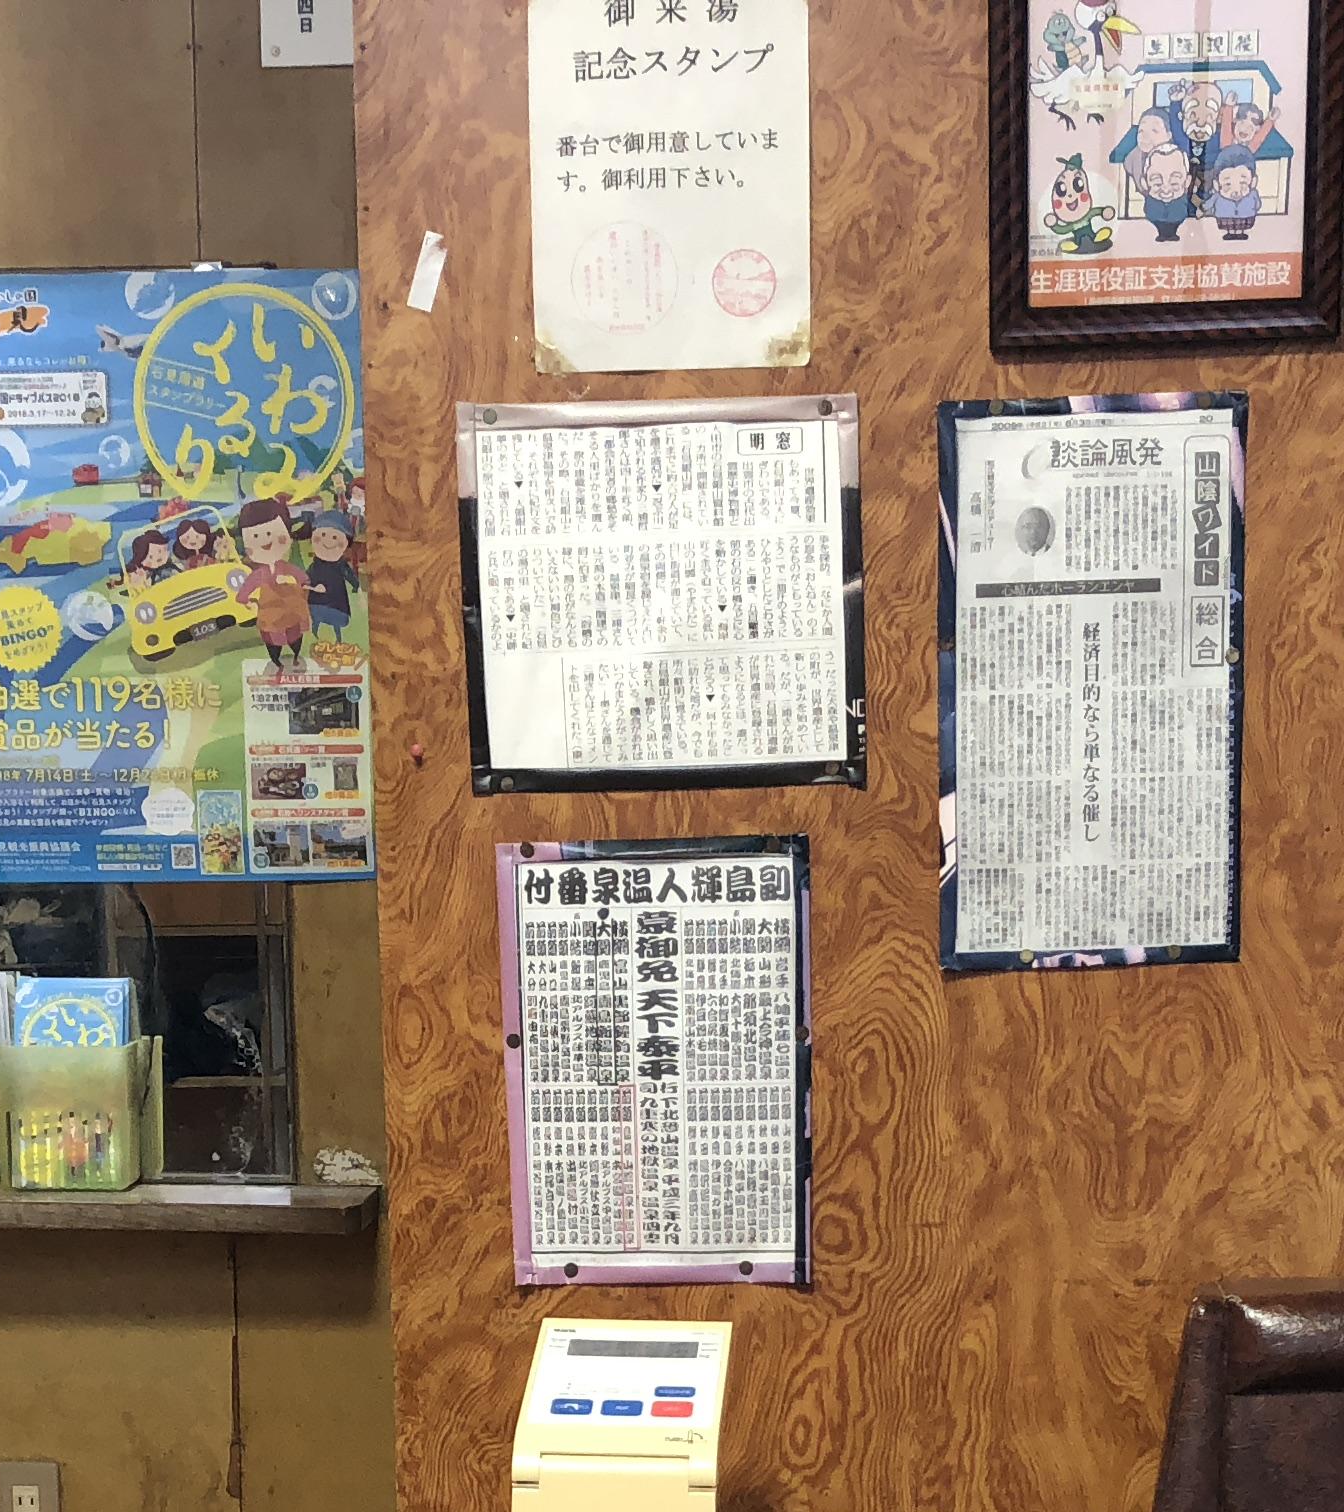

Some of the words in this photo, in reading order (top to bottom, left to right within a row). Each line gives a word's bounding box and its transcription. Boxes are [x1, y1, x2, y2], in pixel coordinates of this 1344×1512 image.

[573, 43, 775, 83] 記念スタンプ
[556, 129, 780, 157] 番台で御用意していま
[557, 166, 745, 193] す。御利用下さい。
[1030, 261, 1292, 295] 生涯現役証支援協賛施設
[749, 431, 792, 451] 明窓
[1050, 437, 1164, 469] 談論風発
[1193, 450, 1223, 587] 山陰ワイド
[193, 623, 218, 637] 103
[1195, 601, 1221, 661] 総合
[1081, 622, 1101, 843] 経済目的なら単なる催し
